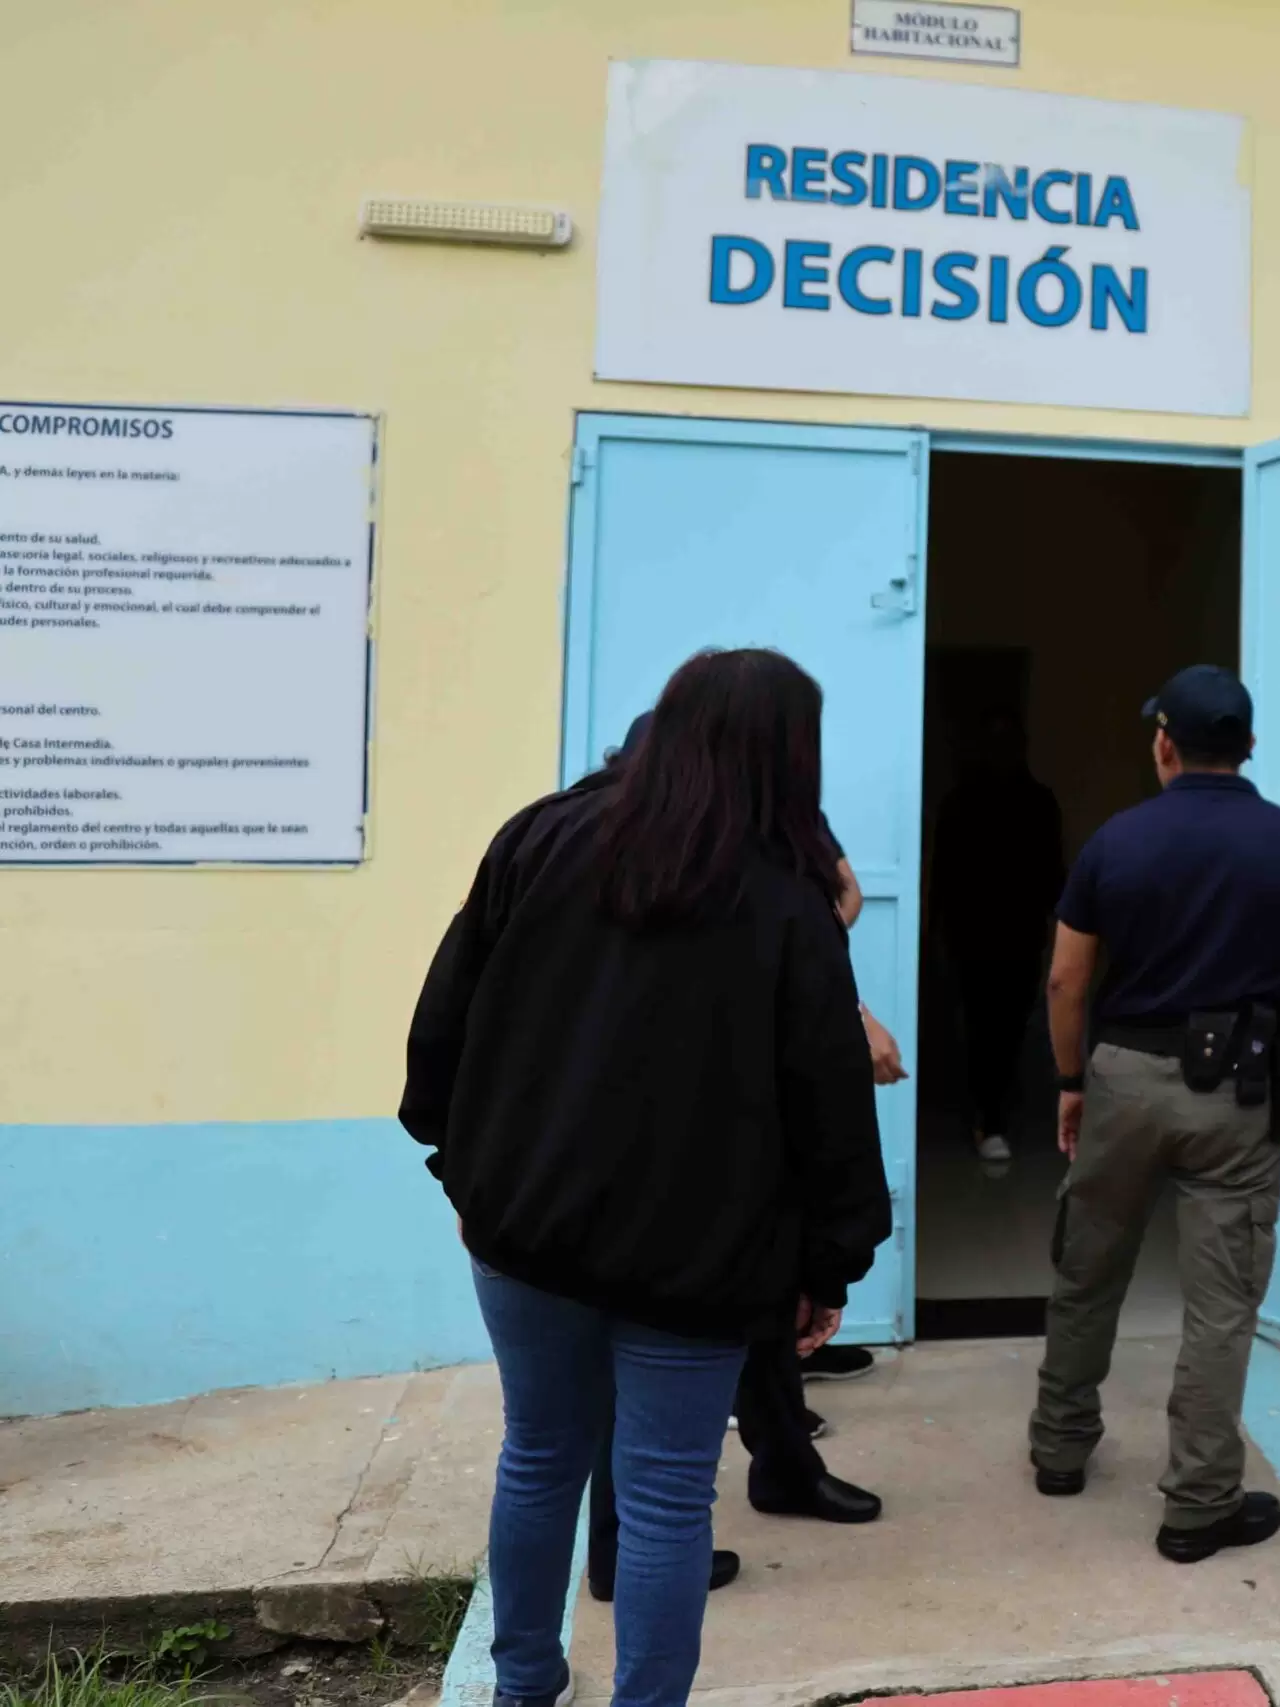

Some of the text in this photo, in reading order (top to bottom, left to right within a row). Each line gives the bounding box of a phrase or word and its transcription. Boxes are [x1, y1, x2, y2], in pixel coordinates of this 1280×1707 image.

[864, 27, 1004, 50] HABITACIONAL
[744, 143, 1140, 231] RESIDENCIA
[708, 234, 1148, 334] DECISIÓN
[0, 414, 174, 439] COMPROMISOS
[14, 468, 21, 479] y
[66, 468, 96, 481] leyes
[100, 470, 114, 479] en
[117, 468, 128, 480] la
[30, 532, 45, 543] de
[48, 535, 62, 544] su
[4, 565, 14, 576] la
[17, 565, 79, 578] formación
[82, 567, 150, 580] profesional
[6, 582, 46, 593] dentro
[50, 582, 65, 594] de
[68, 586, 81, 595] su
[34, 600, 81, 611] cultural
[84, 602, 91, 613] y
[162, 602, 172, 613] el
[175, 603, 200, 613] cual
[203, 602, 232, 614] debe
[235, 604, 306, 616] comprender
[37, 704, 56, 715] del
[13, 738, 41, 749] Casa
[14, 756, 21, 768] y
[23, 754, 87, 768] problemas
[91, 756, 164, 767] individuales
[177, 756, 228, 769] grupales
[232, 757, 309, 770] provenientes
[8, 821, 79, 836] reglamento
[81, 822, 100, 833] del
[103, 823, 142, 833] centro
[144, 825, 151, 836] y
[154, 822, 187, 834] todas
[190, 822, 239, 836] aquellas
[243, 825, 265, 836] que
[267, 822, 278, 833] le
[40, 838, 76, 850] orden
[79, 842, 87, 850] o
